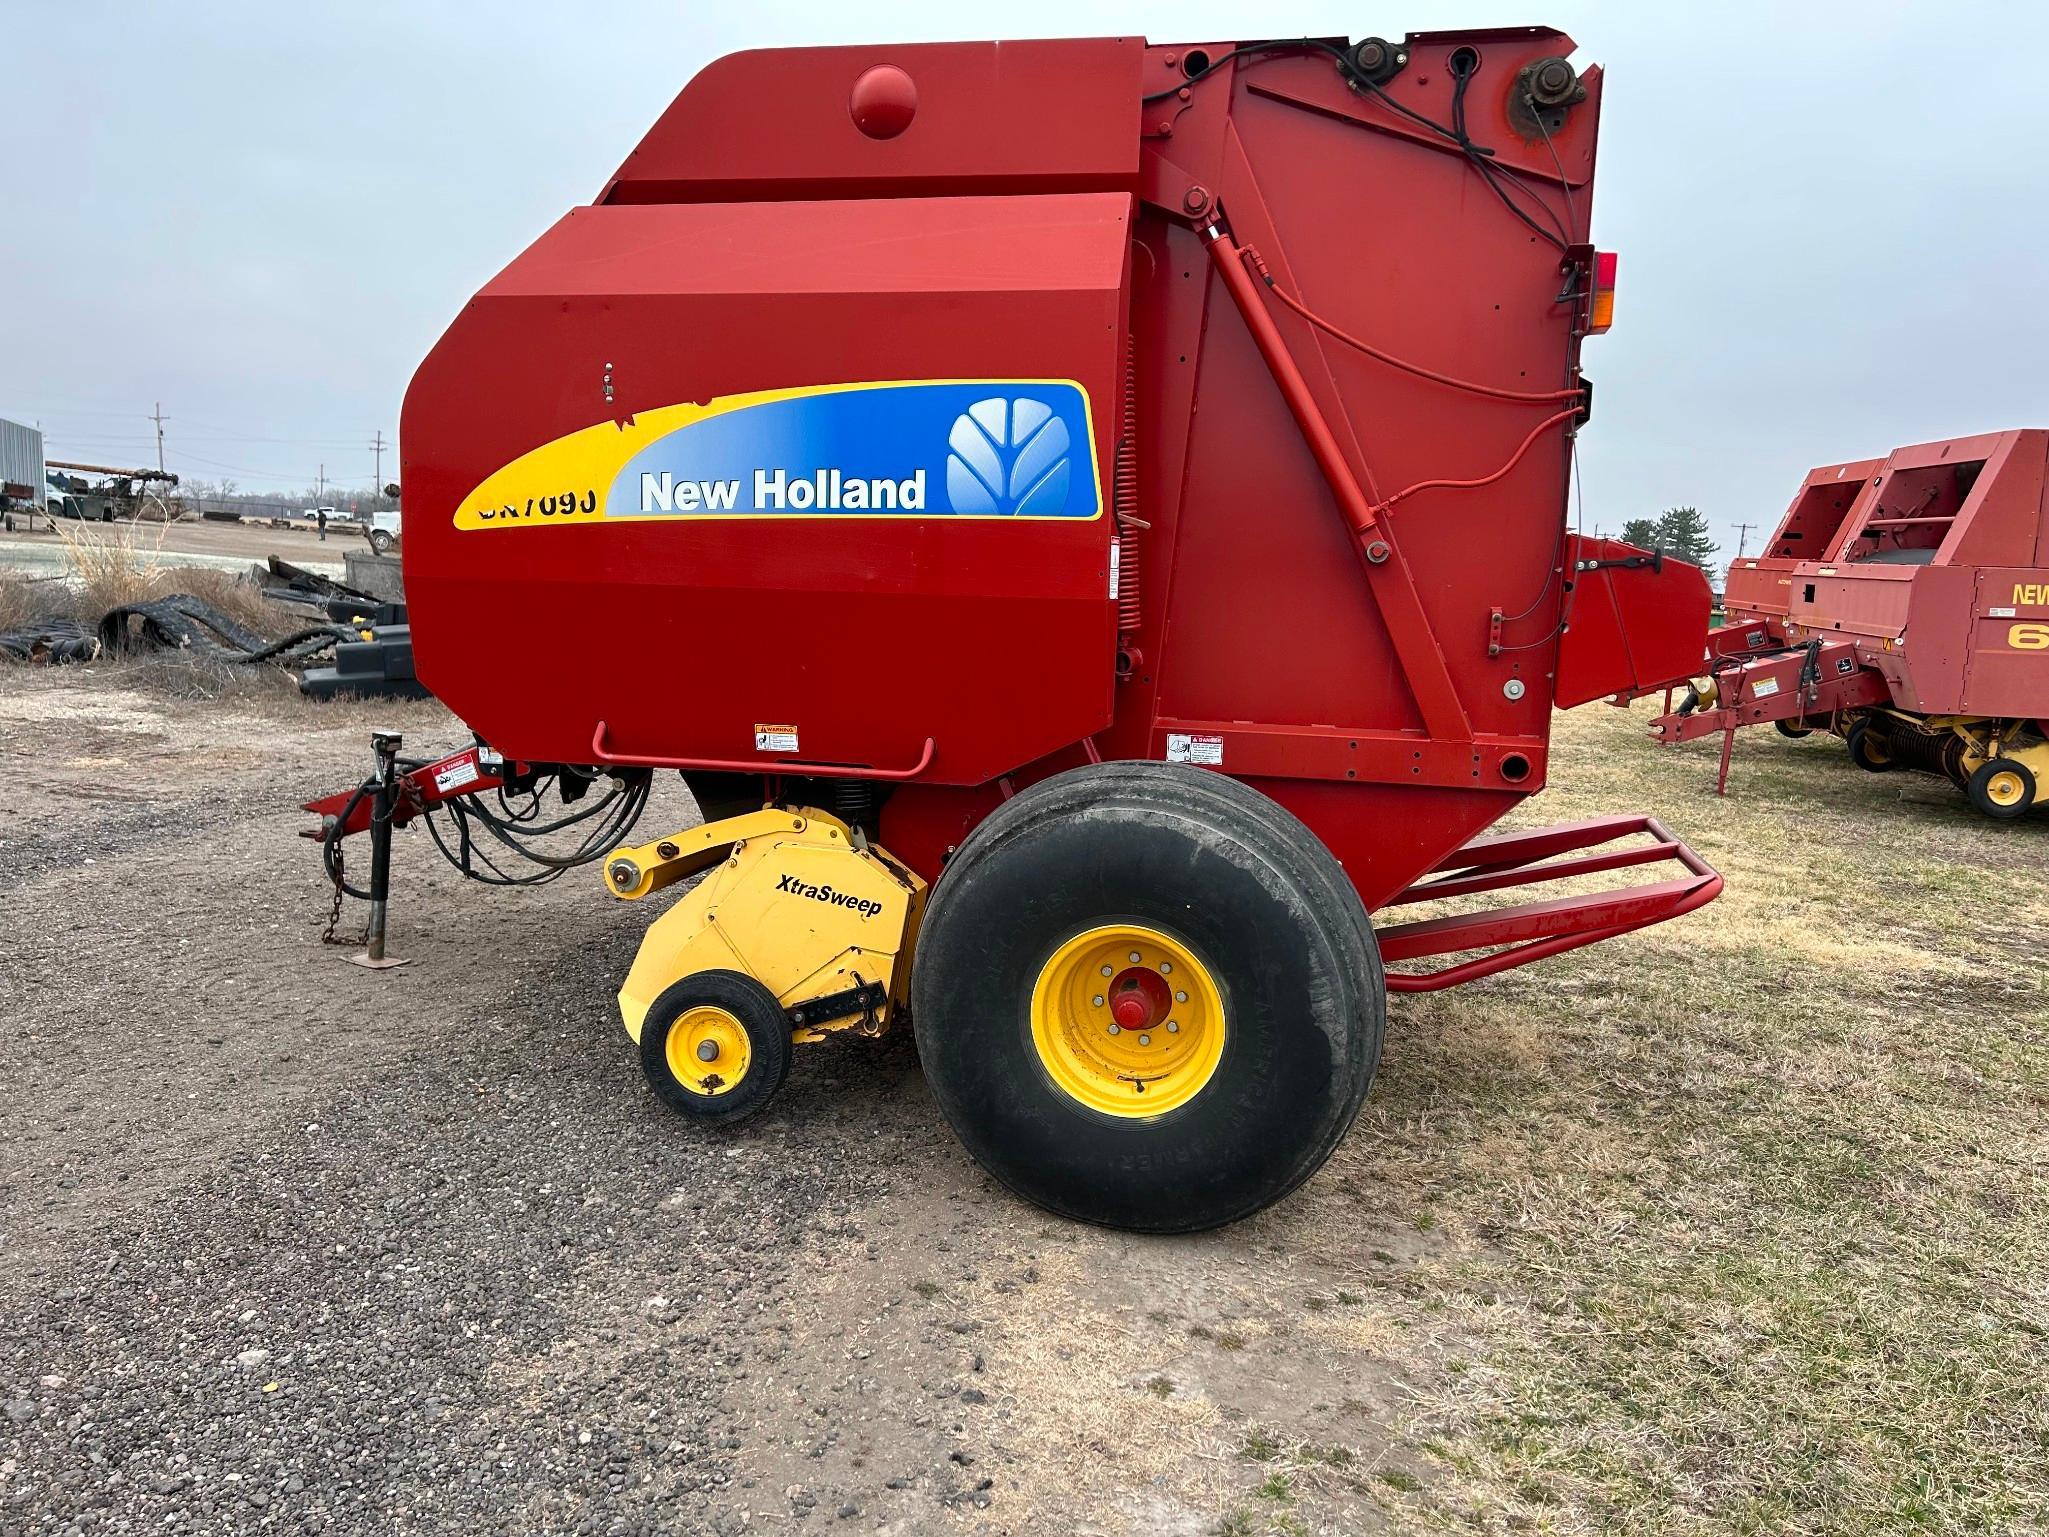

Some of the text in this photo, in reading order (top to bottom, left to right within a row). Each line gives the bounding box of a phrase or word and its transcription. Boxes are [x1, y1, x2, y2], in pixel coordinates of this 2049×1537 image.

[641, 468, 926, 511] New Holland
[775, 873, 882, 917] XtraSweep
